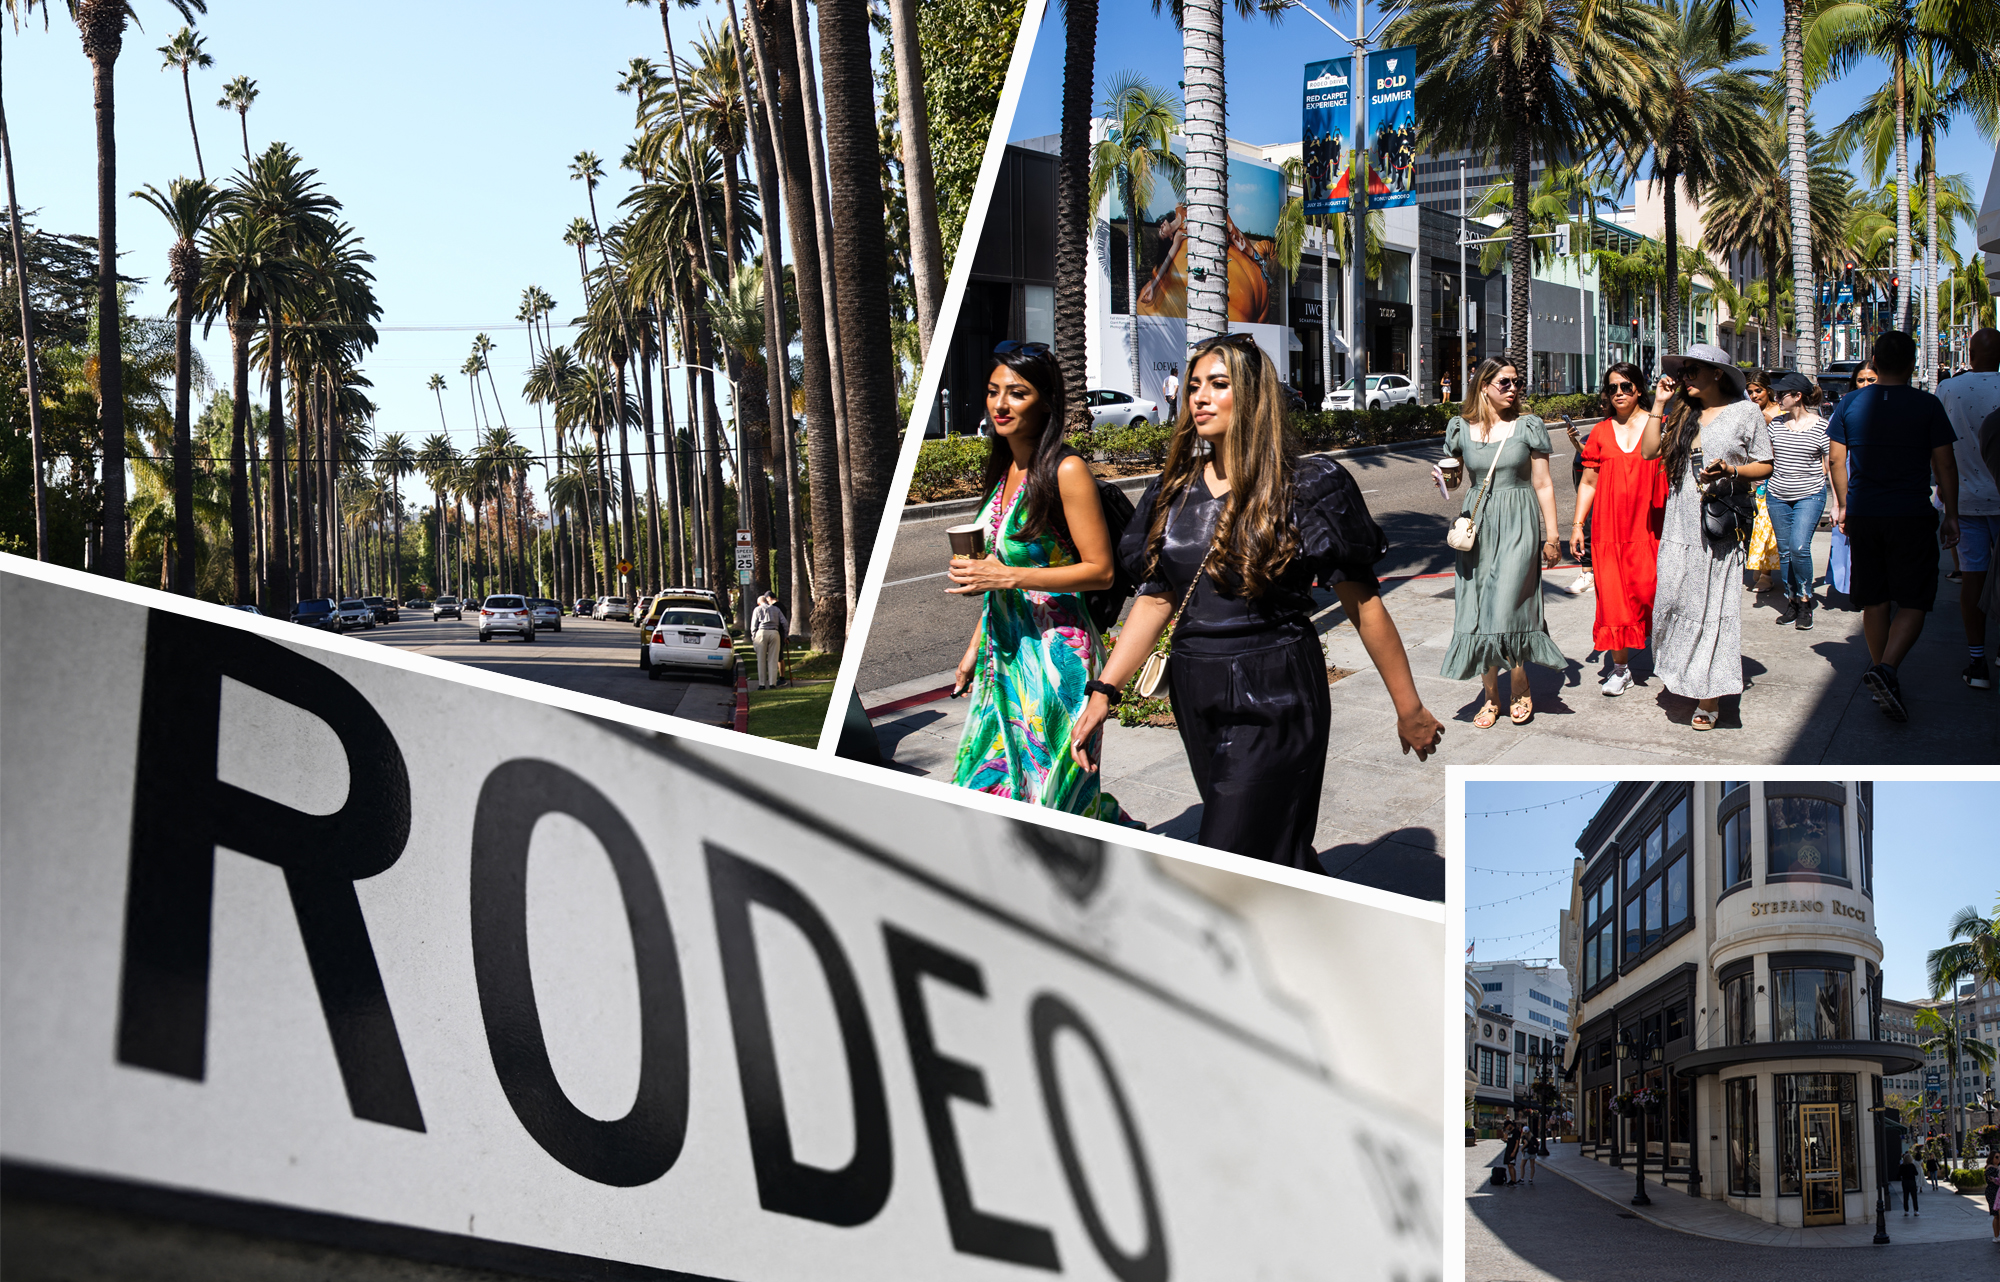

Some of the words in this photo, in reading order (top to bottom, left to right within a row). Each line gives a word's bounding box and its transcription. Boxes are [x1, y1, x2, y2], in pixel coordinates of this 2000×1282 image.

[1309, 80, 1328, 88] RODEO
[1377, 75, 1407, 90] BOLD
[1306, 94, 1321, 103] RED
[1321, 91, 1348, 101] CARPET
[1371, 90, 1412, 105] SUMMER
[1306, 99, 1348, 110] EXPERIENCE
[1305, 303, 1322, 317] IWC
[1153, 361, 1178, 371] LOEWE
[737, 559, 752, 569] 25
[1750, 899, 1824, 917] STEFANO
[1832, 899, 1867, 923] RICCI
[114, 605, 1171, 1282] RODEO
[1798, 1084, 1823, 1092] STEFANO
